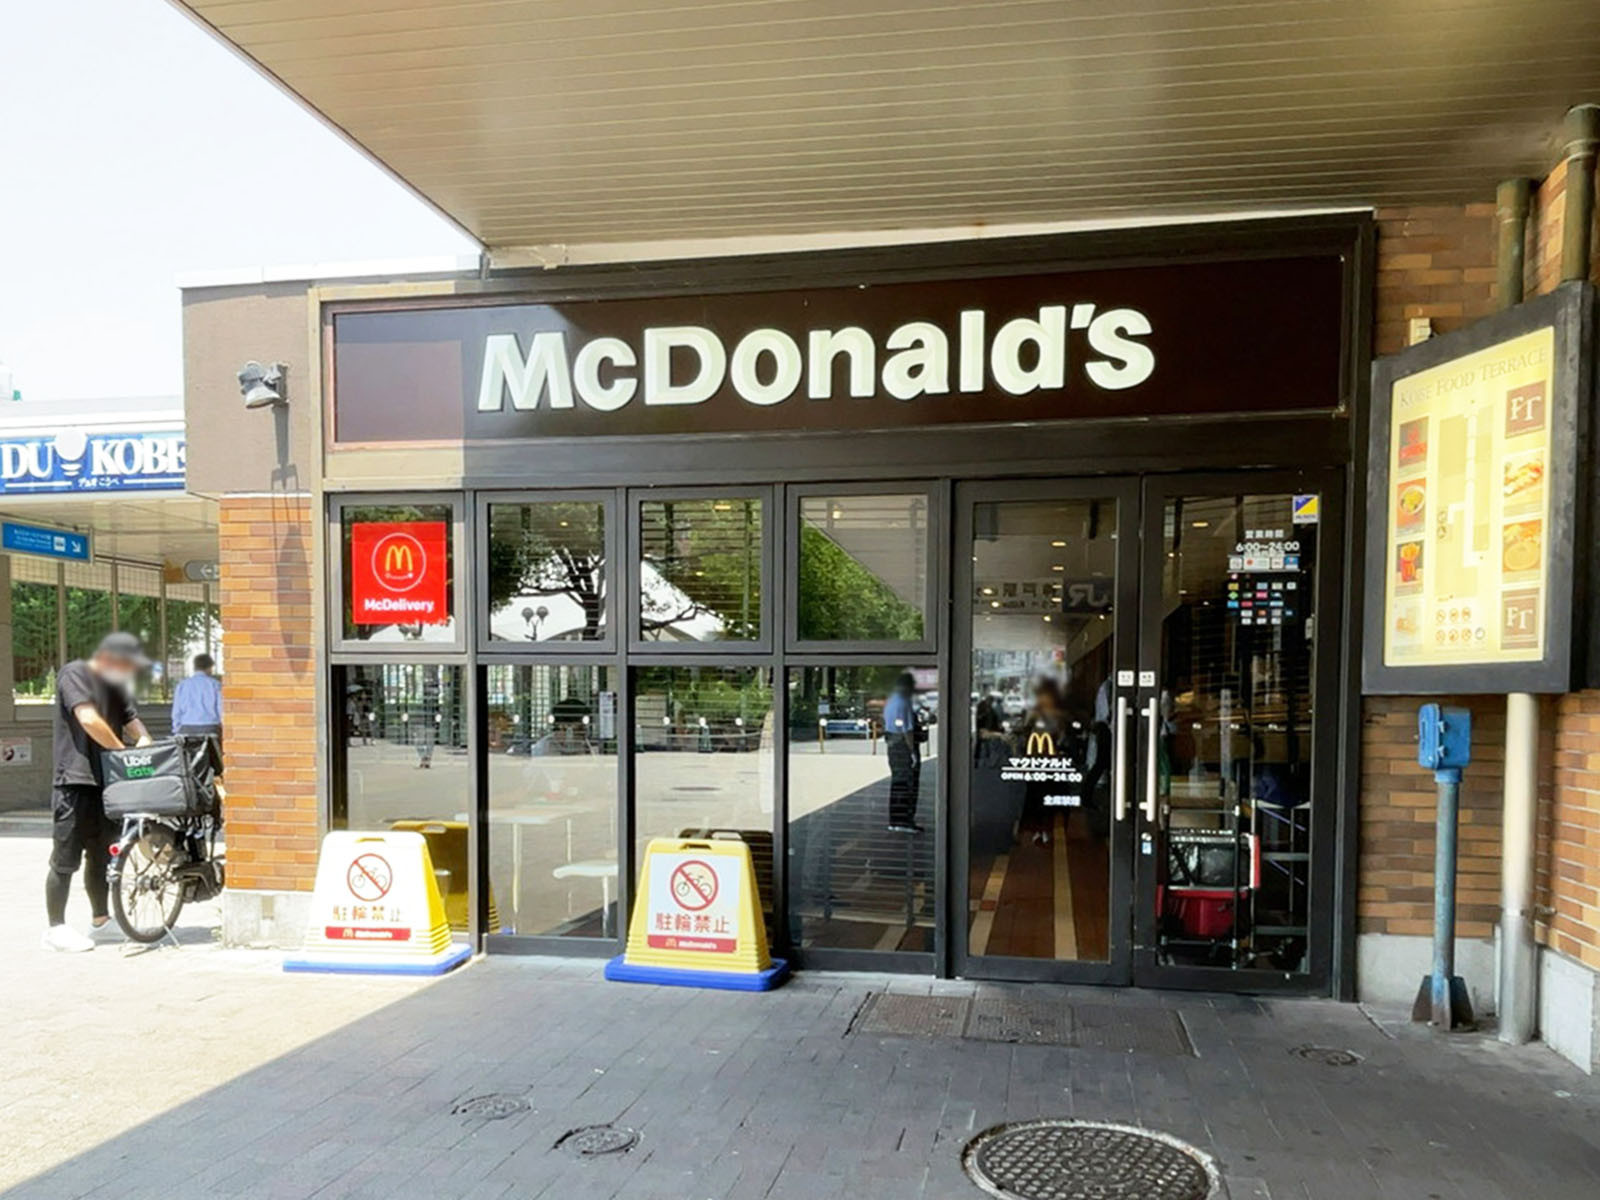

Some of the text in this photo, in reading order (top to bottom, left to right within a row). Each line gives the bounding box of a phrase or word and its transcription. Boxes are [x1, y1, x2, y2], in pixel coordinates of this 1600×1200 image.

[477, 303, 1156, 411] McDonald's
[1436, 371, 1475, 396] FOOD
[1480, 348, 1548, 381] TERRACE
[91, 438, 186, 475] KOBE
[364, 599, 434, 613] McDelivery
[123, 755, 152, 767] Uber
[1008, 757, 1073, 769] マクドナルド
[1001, 772, 1024, 781] OPEN
[655, 912, 731, 934] 駐輪禁止
